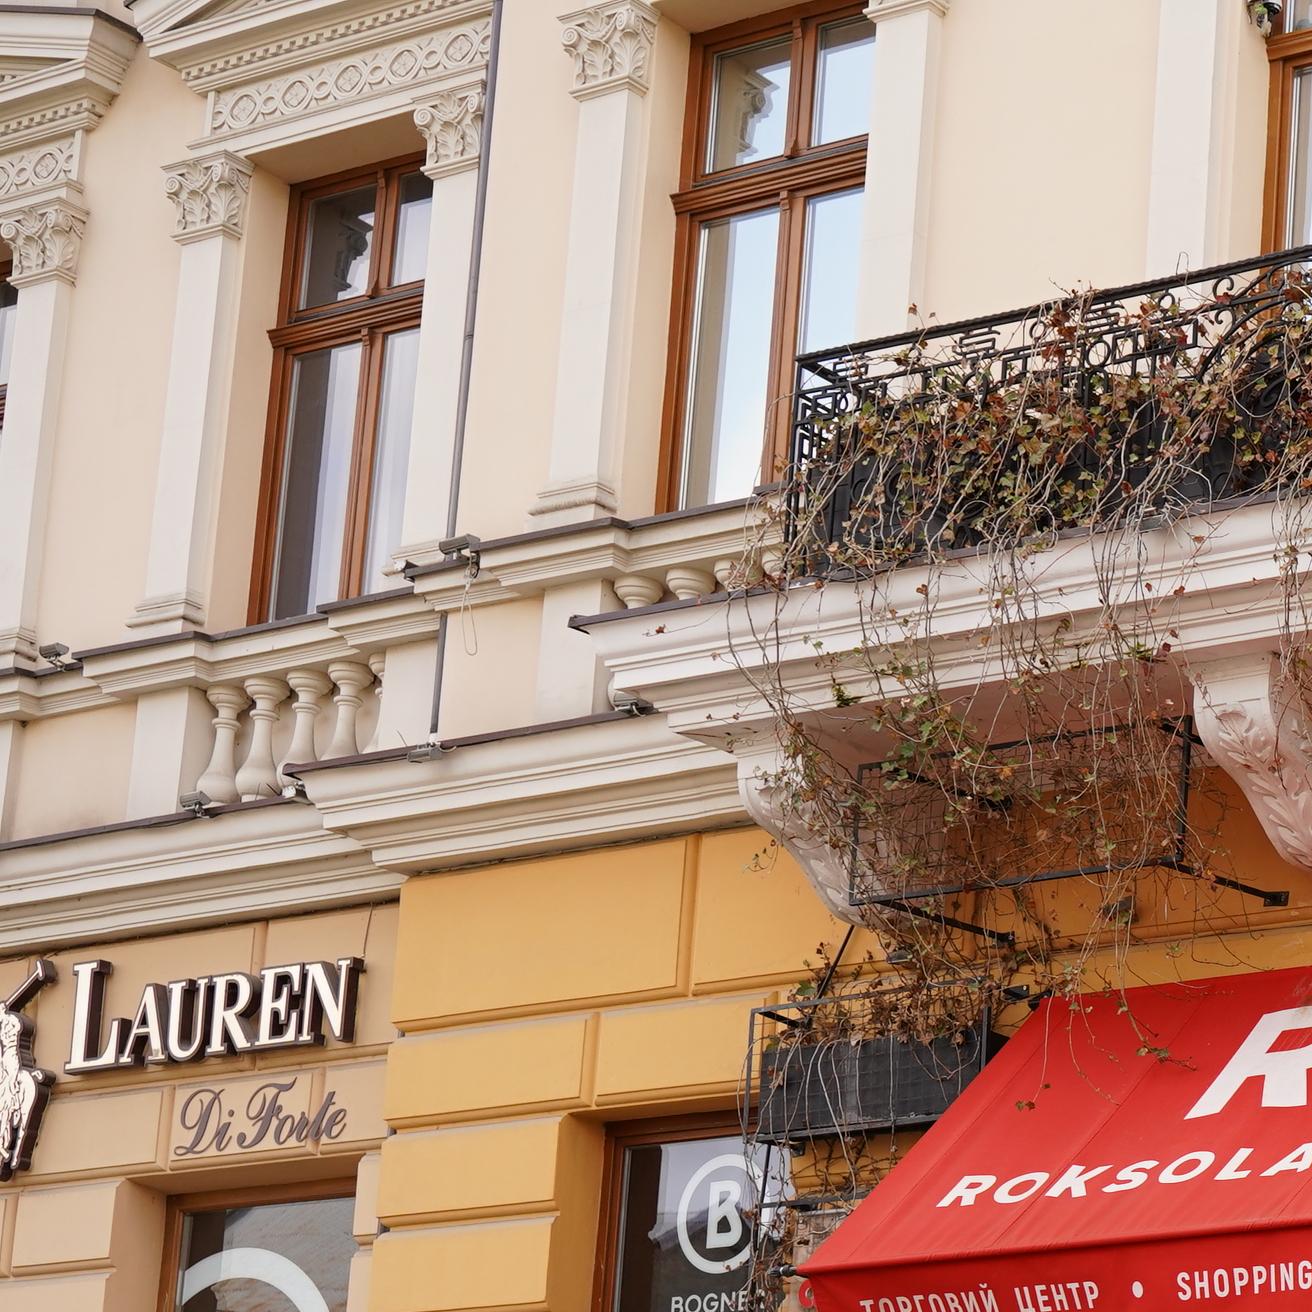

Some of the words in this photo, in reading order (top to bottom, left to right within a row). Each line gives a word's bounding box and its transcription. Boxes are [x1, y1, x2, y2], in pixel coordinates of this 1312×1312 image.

[65, 957, 363, 1075] LAUREN
[174, 1088, 236, 1156] Di
[237, 1076, 348, 1150] Forte
[1176, 1259, 1312, 1302] SHOPPING
